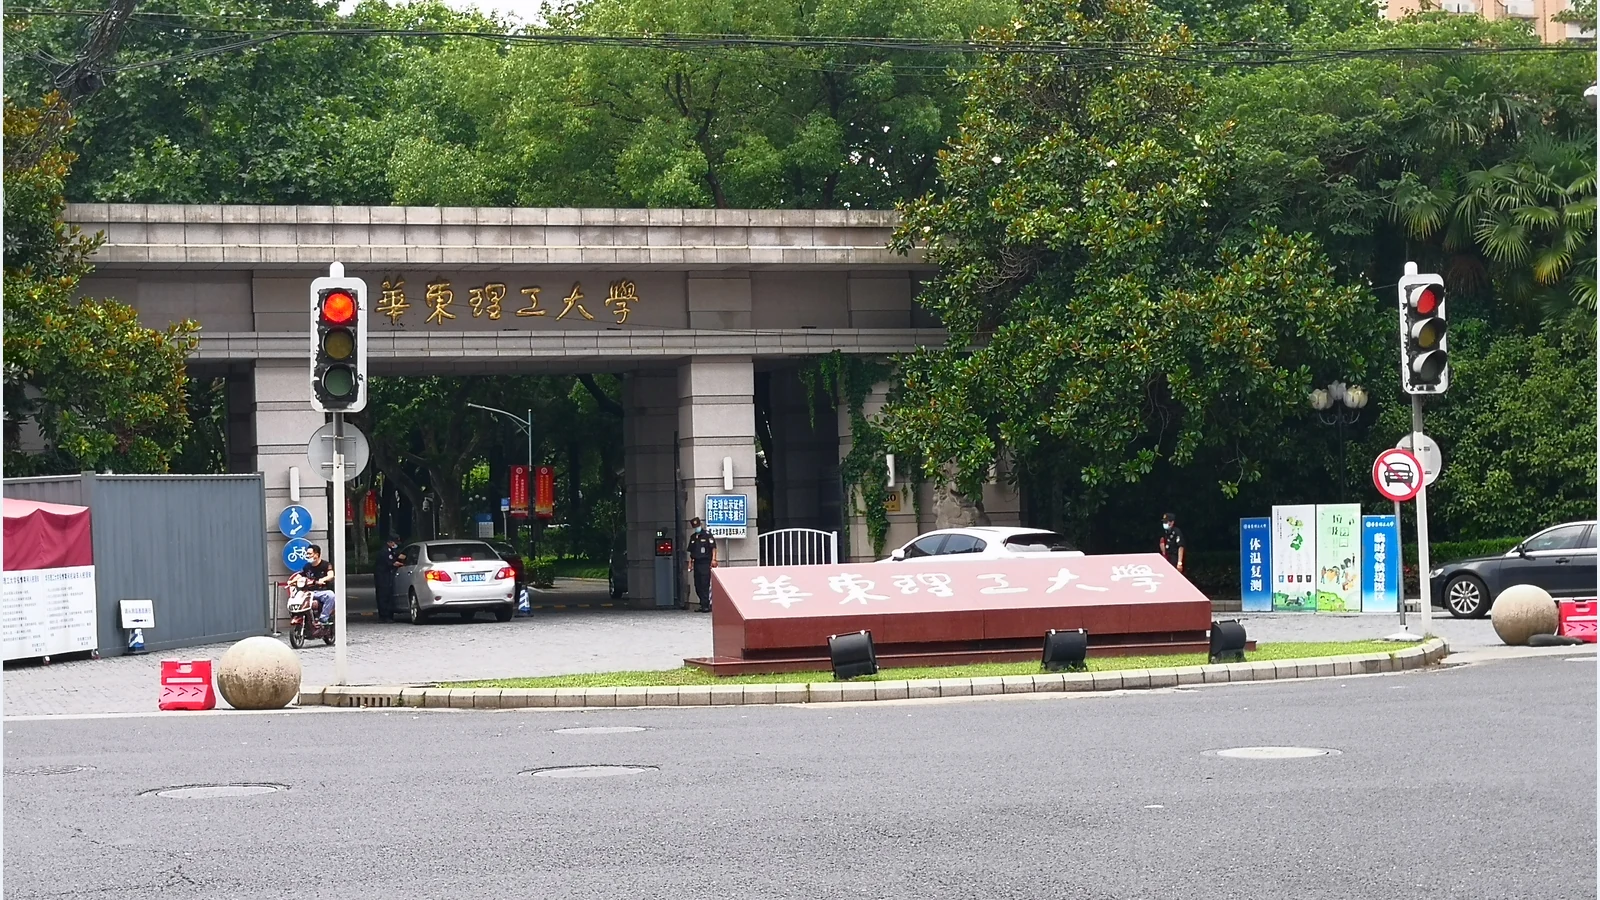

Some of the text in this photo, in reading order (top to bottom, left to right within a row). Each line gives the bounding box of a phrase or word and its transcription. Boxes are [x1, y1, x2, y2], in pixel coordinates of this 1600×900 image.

[374, 275, 640, 325] 華東理工大學
[708, 510, 744, 521] 自行车下车推行
[751, 563, 1165, 610] 華東理工大學
[1249, 537, 1263, 592] 体温复测
